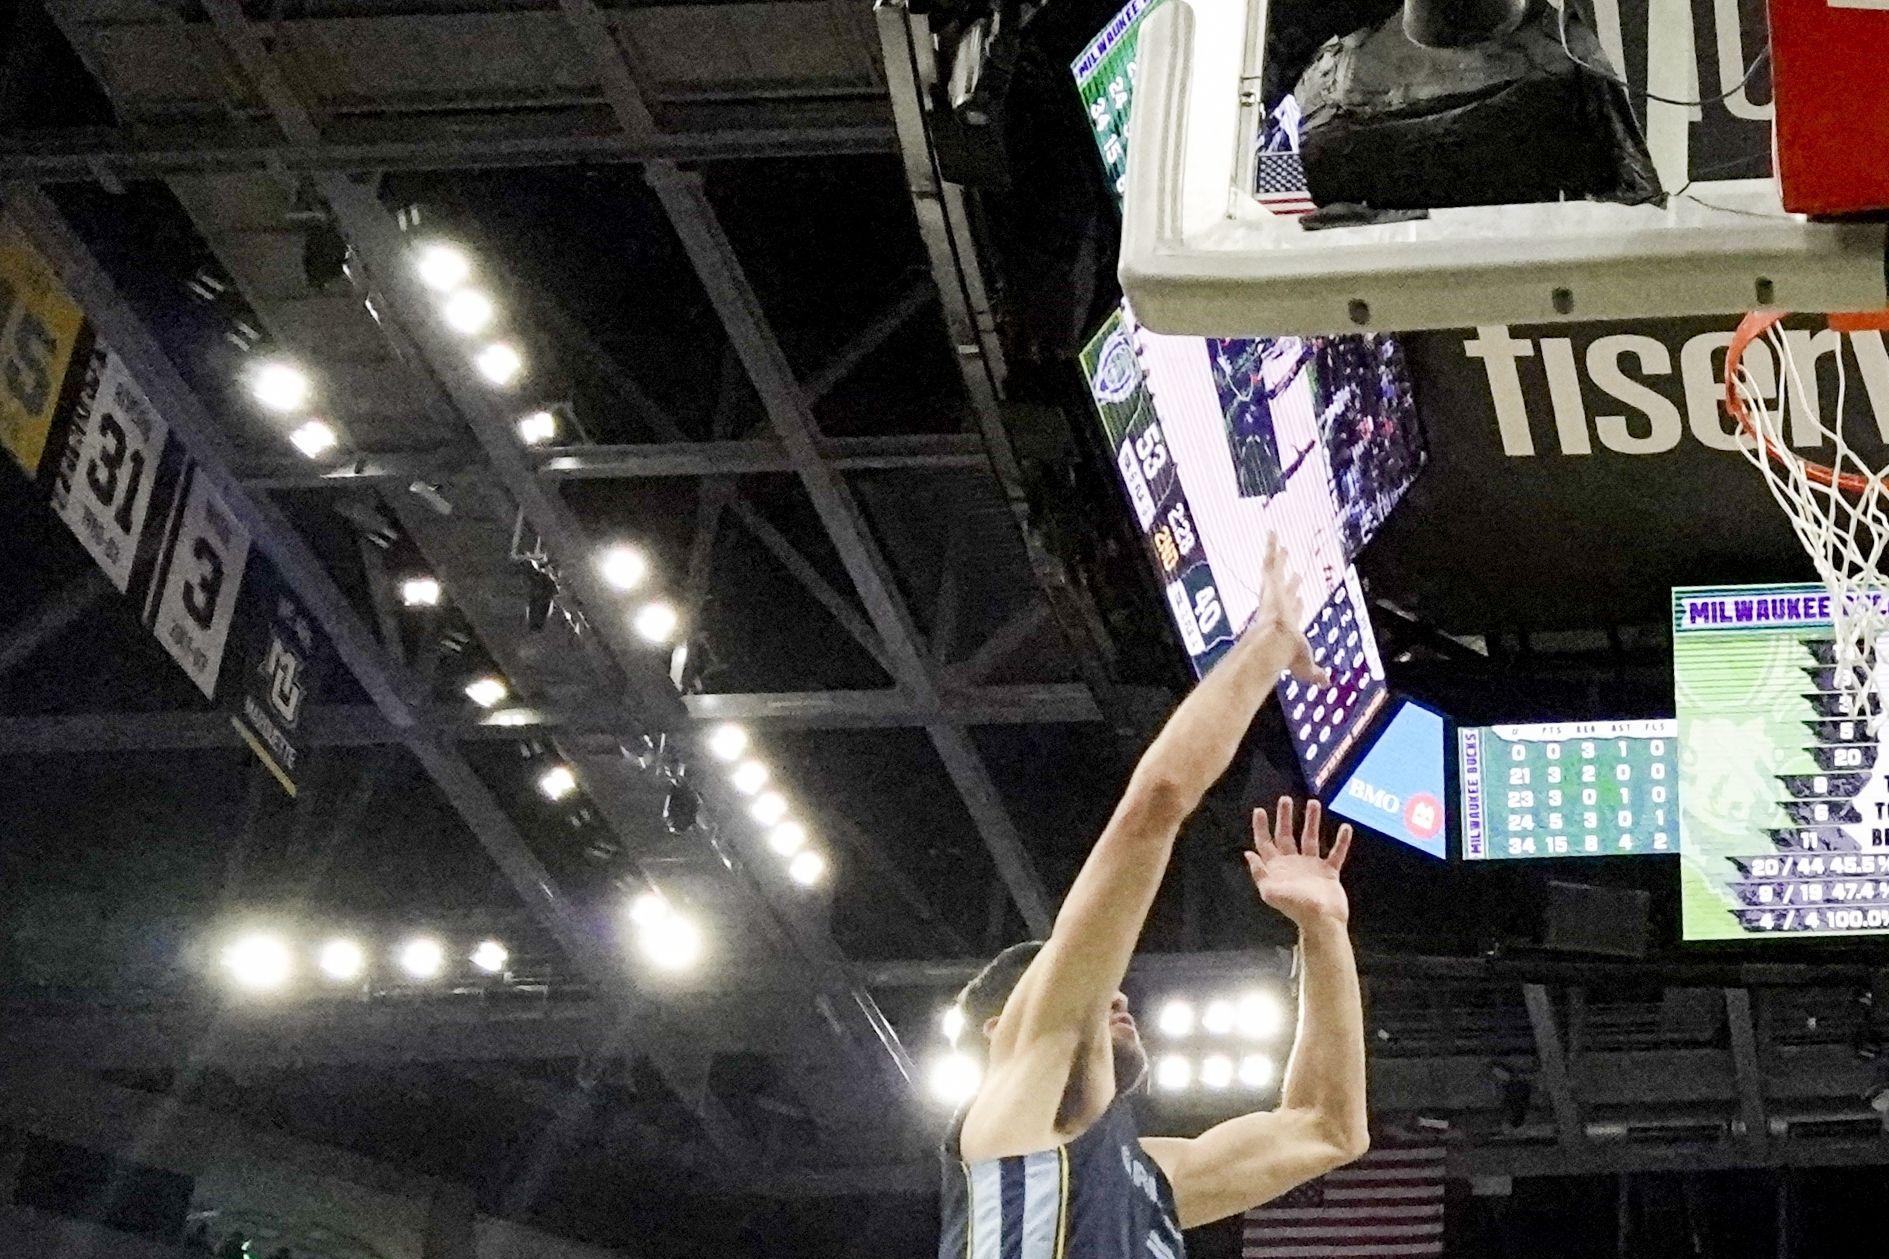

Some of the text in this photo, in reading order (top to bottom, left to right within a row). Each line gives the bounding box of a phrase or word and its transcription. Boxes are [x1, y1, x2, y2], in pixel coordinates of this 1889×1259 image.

[1078, 0, 1138, 78] MILWAUKEE
[1135, 424, 1167, 480] 53
[86, 412, 146, 536] 31
[1166, 503, 1195, 554] 2:28
[183, 536, 224, 631] 3
[1193, 584, 1221, 634] 40
[1690, 596, 1830, 624] MILWAUKEE
[1511, 739, 1665, 762] 0 0 3 1 0
[1834, 747, 1862, 766] 20
[1509, 763, 1665, 785] 21 3 2 0 0
[1349, 778, 1400, 813] BMO
[1465, 732, 1482, 856] MILWAUKEE BUCKS
[1508, 786, 1666, 808] 23 3 0 1 0
[1508, 809, 1665, 831] 24 5 3 0 1
[1508, 832, 1667, 855] 34 15 8 4 2
[1800, 832, 1818, 848] 11
[1751, 859, 1779, 877] 20
[1797, 857, 1825, 875] 44
[1760, 912, 1775, 930] 4
[1805, 911, 1820, 929] 4
